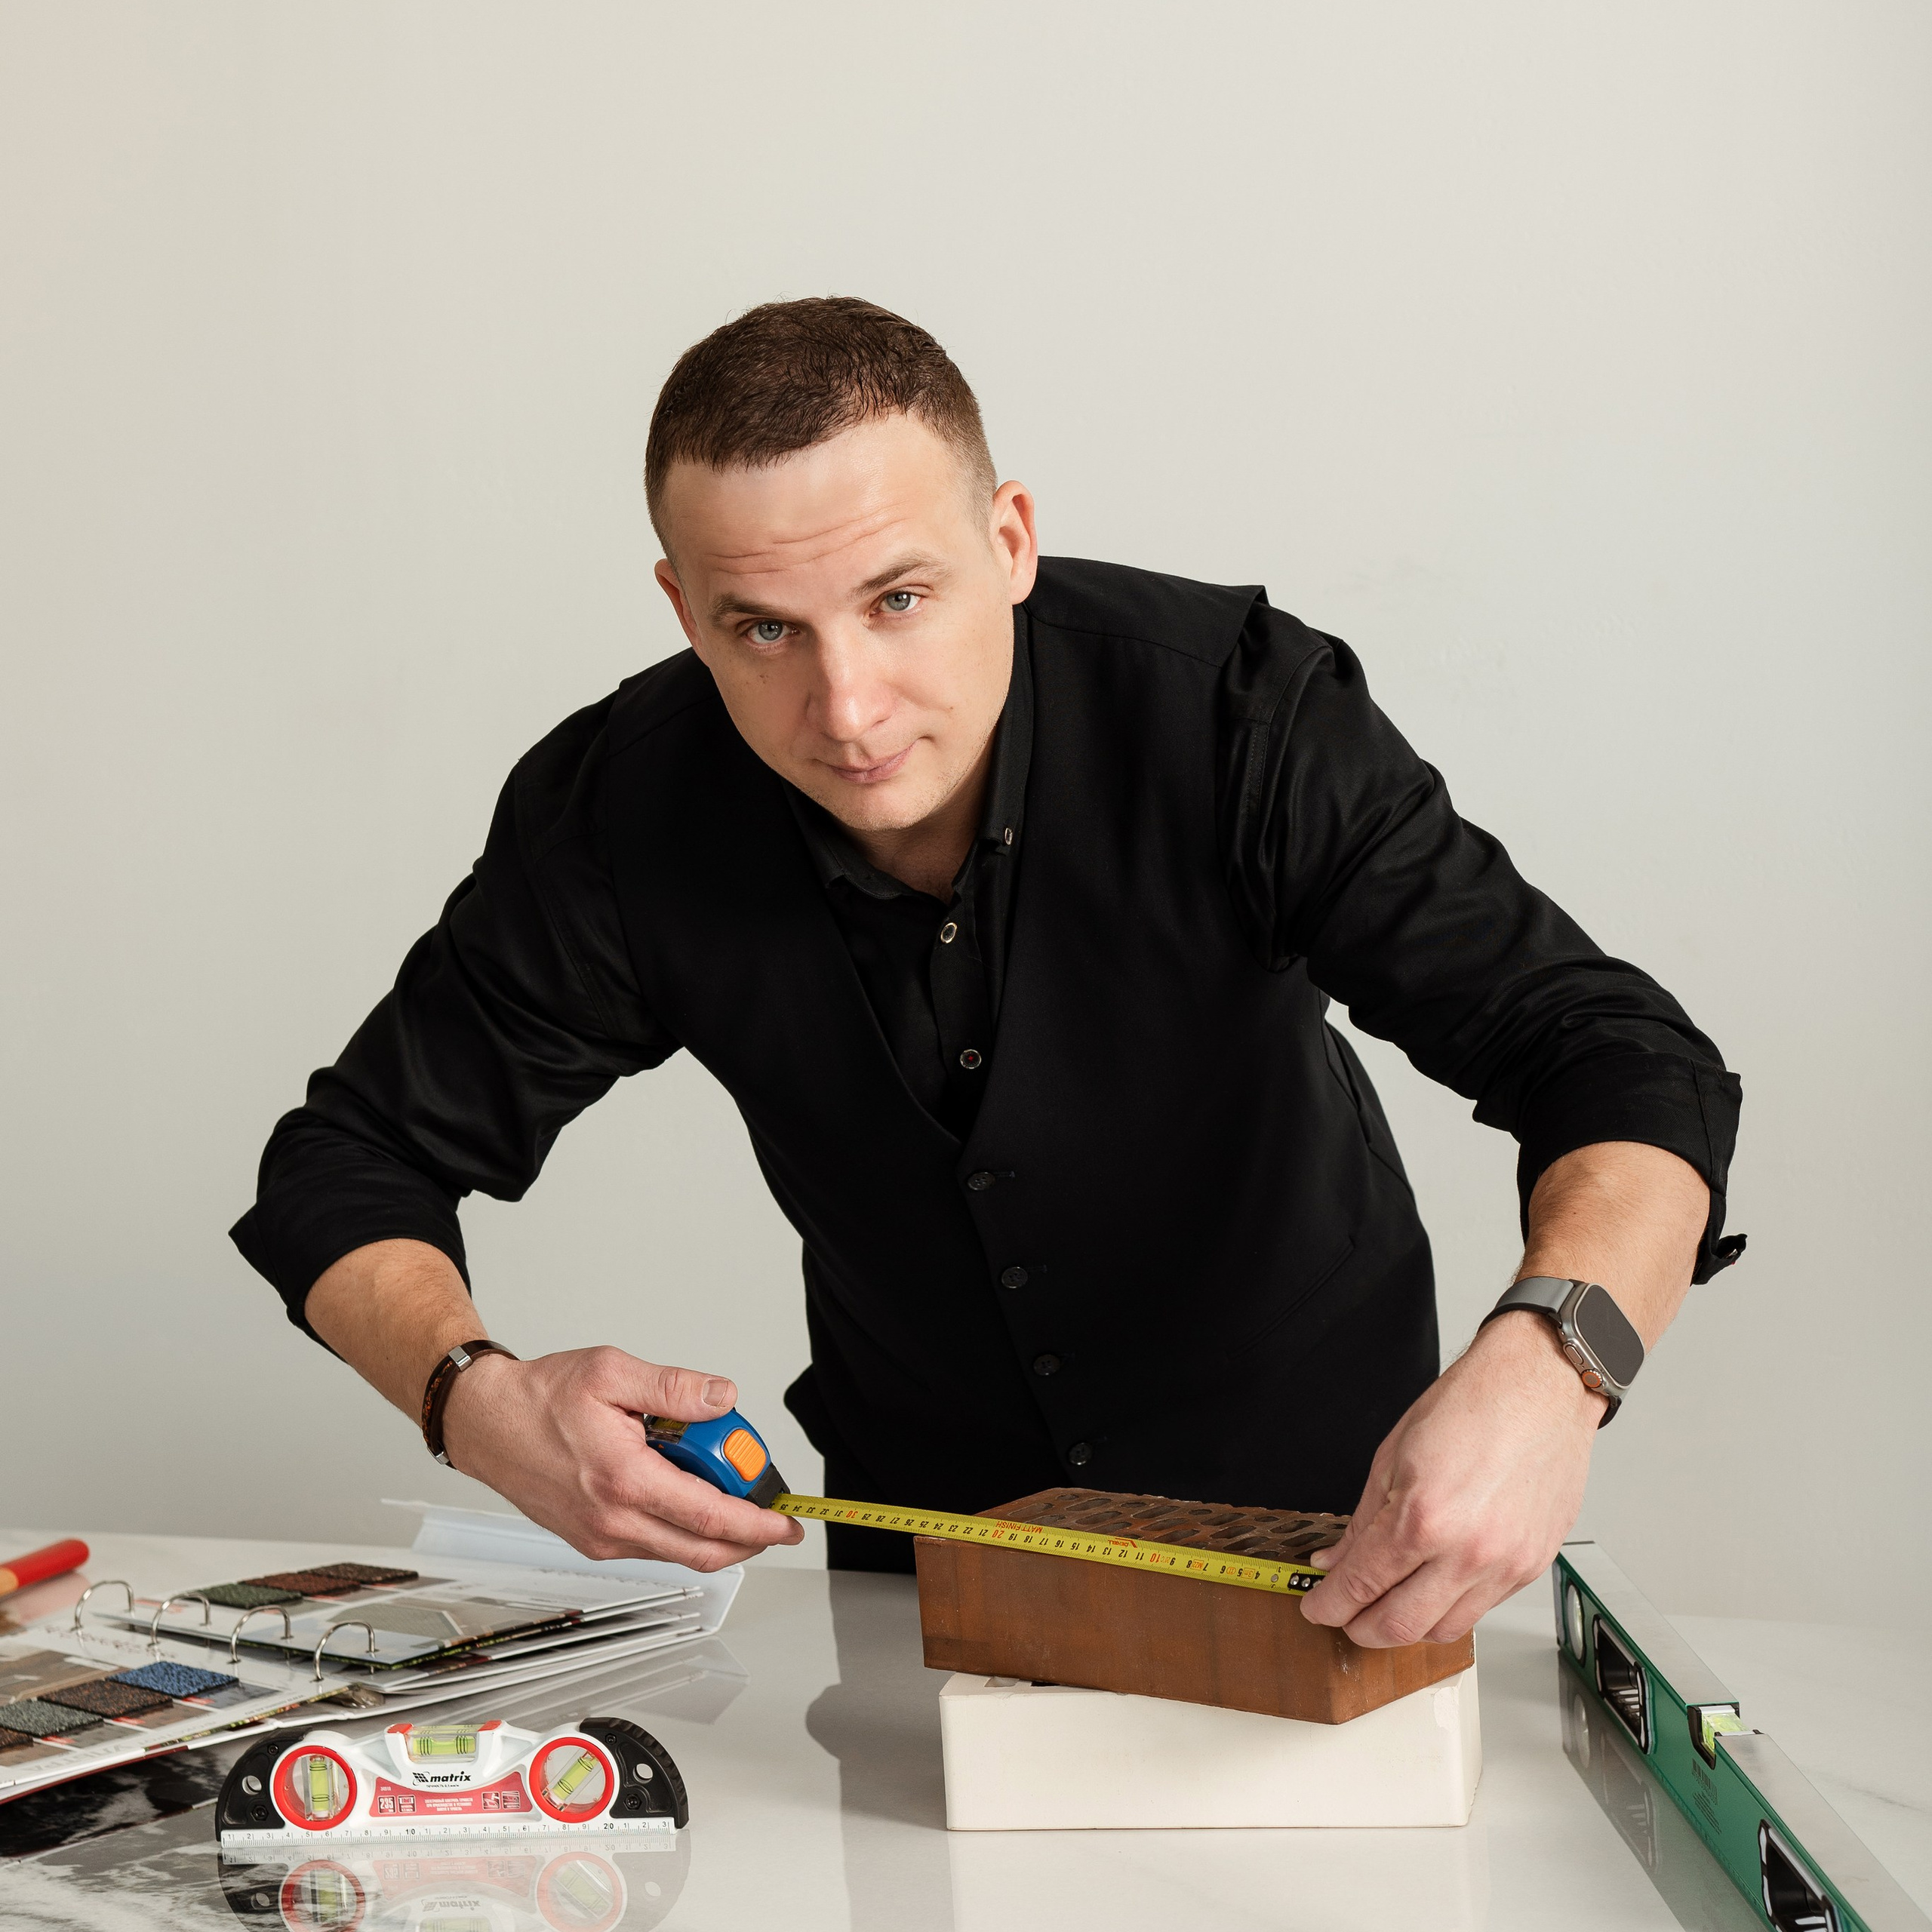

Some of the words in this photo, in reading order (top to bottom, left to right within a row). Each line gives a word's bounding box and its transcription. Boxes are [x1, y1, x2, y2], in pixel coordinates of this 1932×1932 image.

[845, 1509, 859, 1518] 30
[995, 1520, 1020, 1531] FINISH
[1020, 1524, 1043, 1534] MATT
[963, 1526, 974, 1535] 22
[992, 1529, 1005, 1540] 20
[1023, 1535, 1033, 1543] 18
[1038, 1537, 1049, 1546] 17
[1055, 1540, 1064, 1548] 16
[1070, 1542, 1081, 1550] 15
[1085, 1544, 1096, 1553] 14
[1102, 1547, 1112, 1556] 13
[1118, 1549, 1129, 1558] 12
[1135, 1552, 1145, 1561] 11
[1149, 1553, 1161, 1564] 10
[1169, 1557, 1176, 1565] 9
[1186, 1559, 1192, 1568] 8
[1203, 1562, 1209, 1571] 7
[1220, 1565, 1227, 1574] 6
[1236, 1568, 1244, 1577] 5
[1254, 1571, 1260, 1580] 4
[430, 1770, 471, 1783] matrix
[379, 1798, 394, 1810] 235
